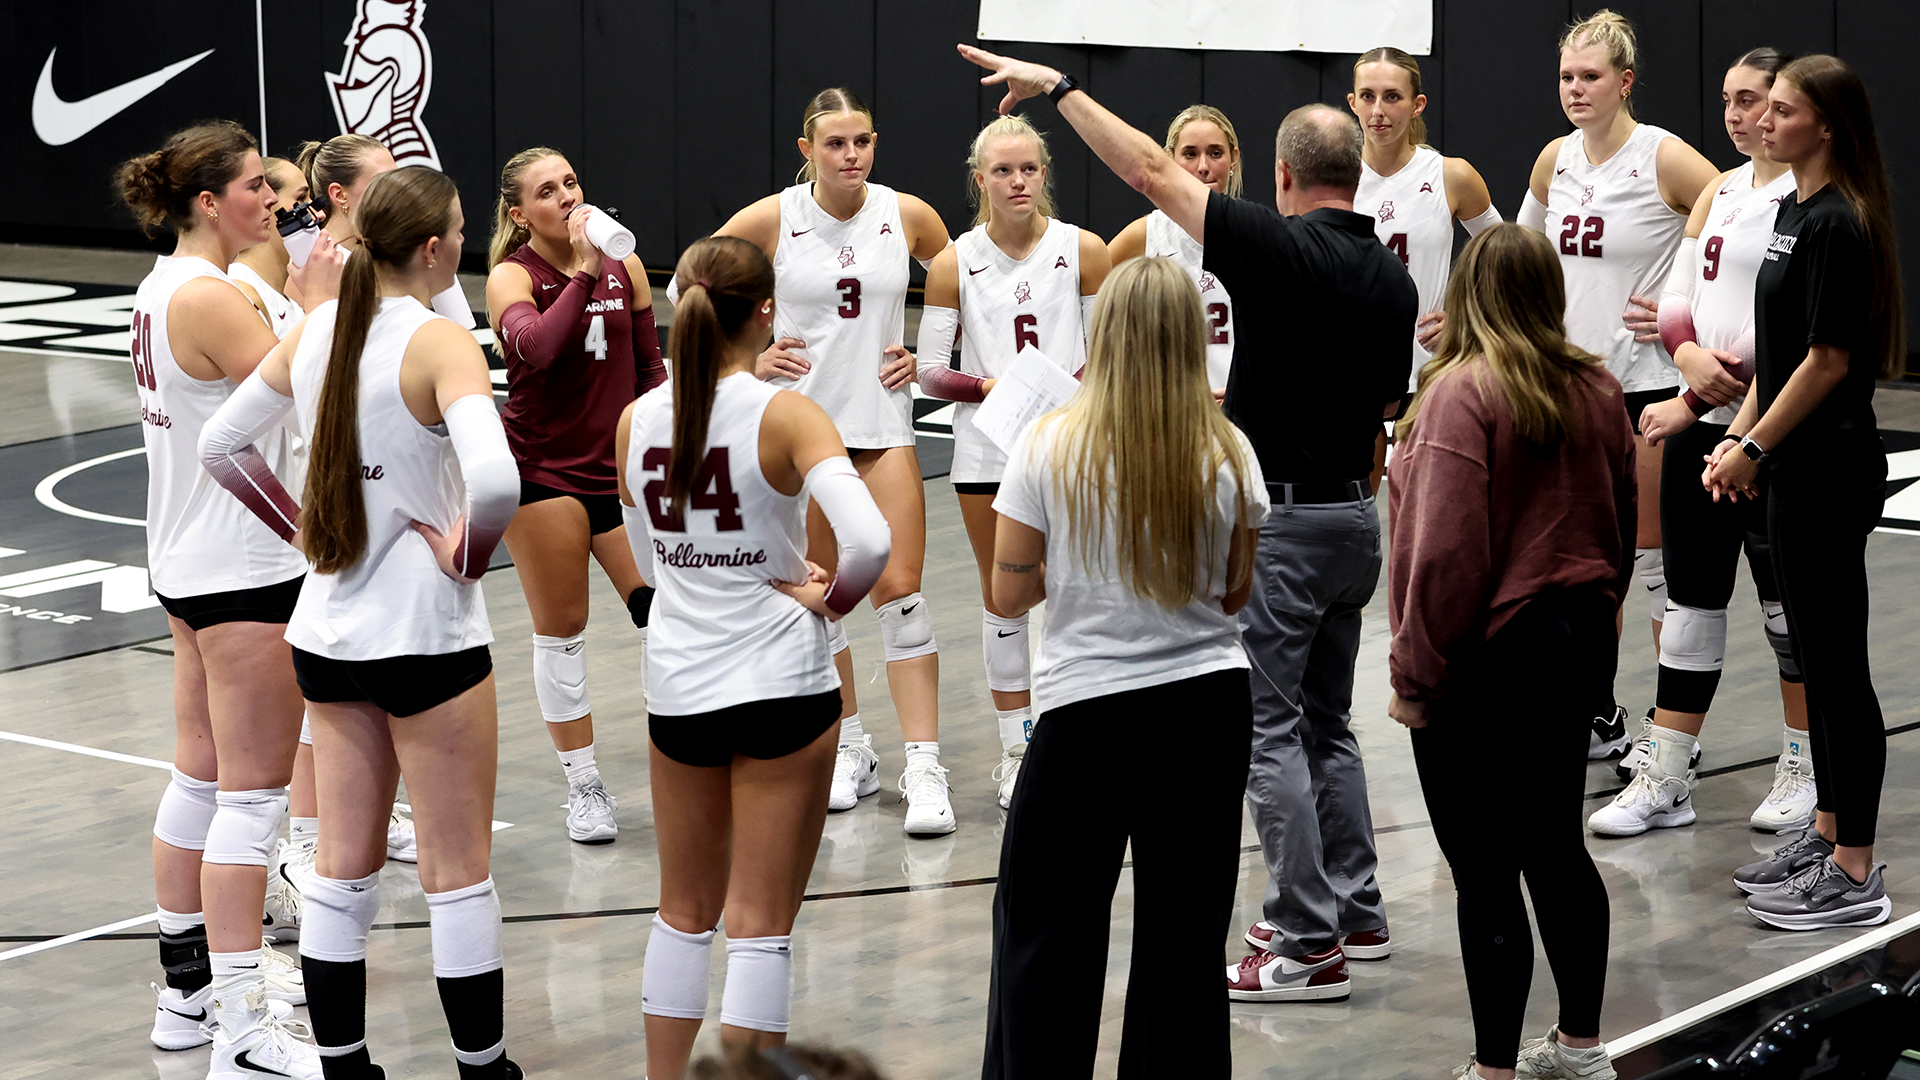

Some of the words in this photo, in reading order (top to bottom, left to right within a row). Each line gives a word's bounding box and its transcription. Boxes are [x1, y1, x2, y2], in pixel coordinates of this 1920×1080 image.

[1386, 232, 1409, 272] 4
[1560, 214, 1605, 258] 22
[1703, 235, 1724, 281] 9
[836, 277, 861, 319] 3
[584, 314, 608, 361] 4
[1014, 313, 1039, 354] 6
[1206, 302, 1229, 345] 2
[131, 309, 157, 392] 20
[642, 446, 745, 534] 24
[653, 539, 768, 569] Bellarmine
